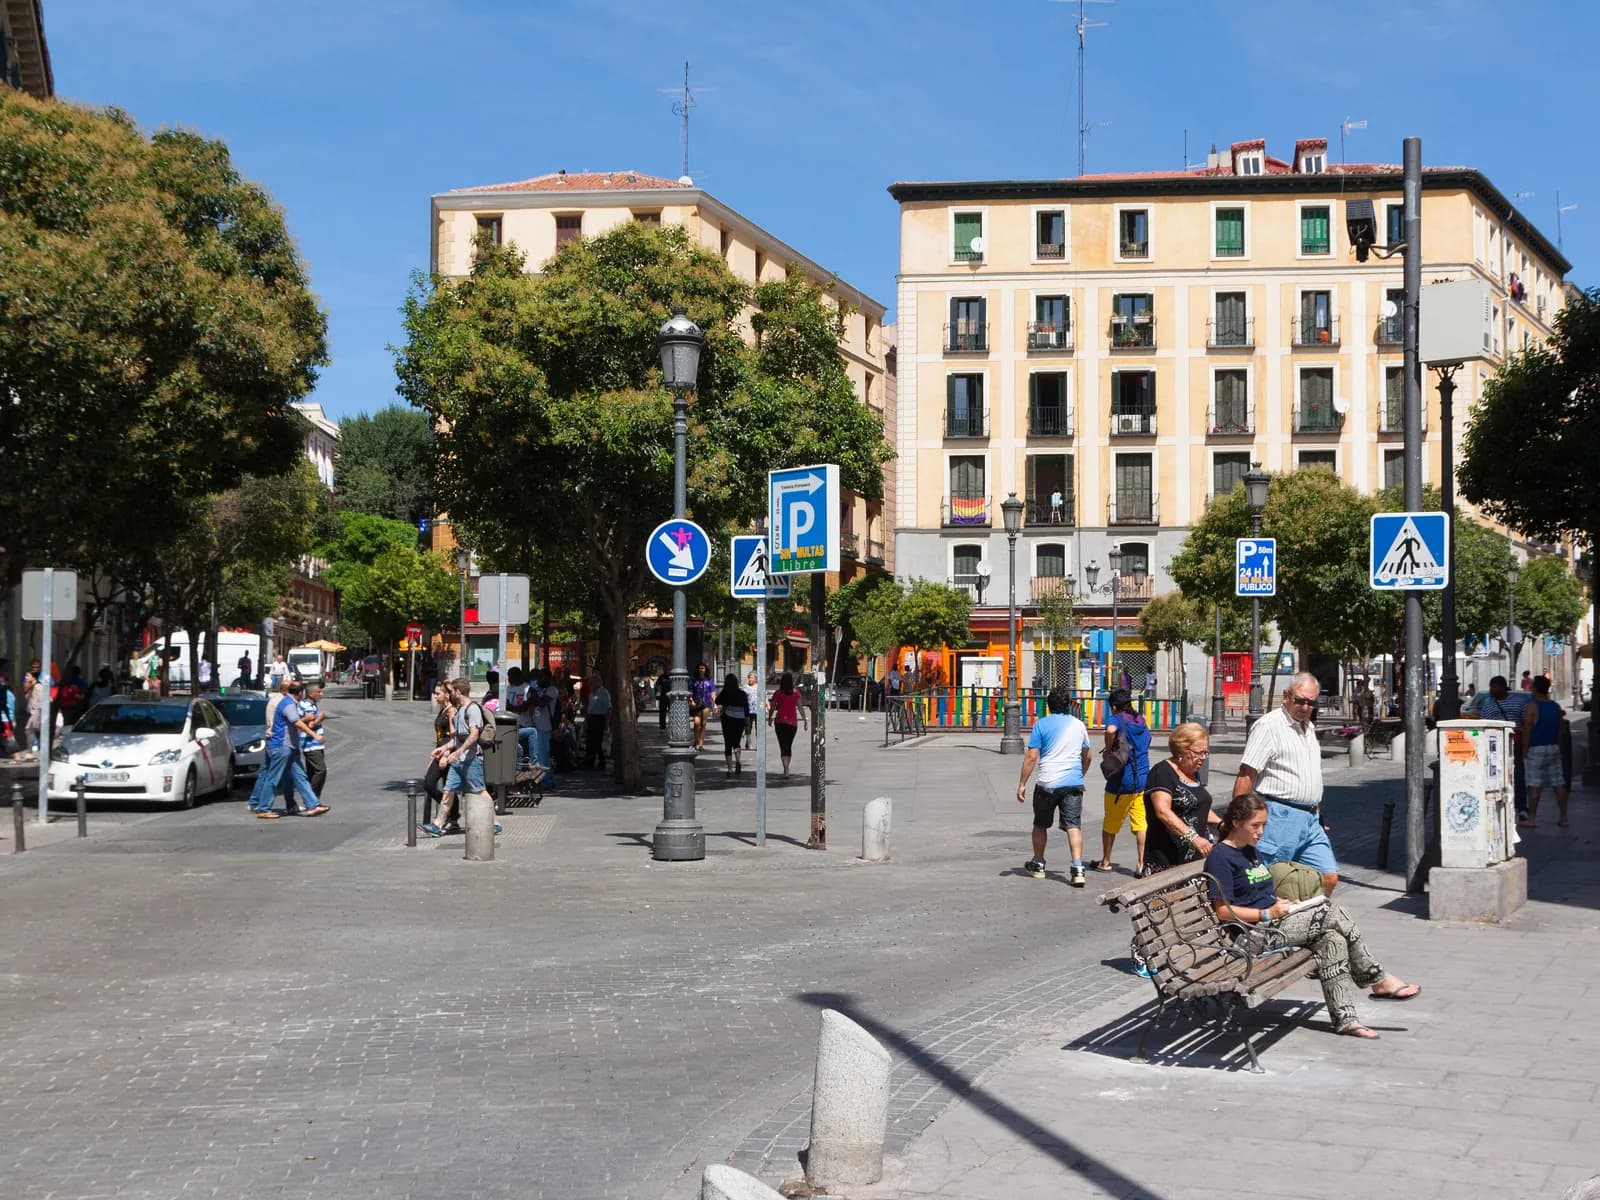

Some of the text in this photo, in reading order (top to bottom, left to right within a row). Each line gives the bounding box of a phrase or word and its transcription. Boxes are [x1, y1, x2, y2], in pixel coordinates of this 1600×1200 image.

[790, 501, 815, 552] P
[780, 545, 824, 560] SIN MULTAS
[1240, 542, 1257, 564] P
[782, 560, 815, 571] Libre
[1240, 567, 1262, 578] 24 H
